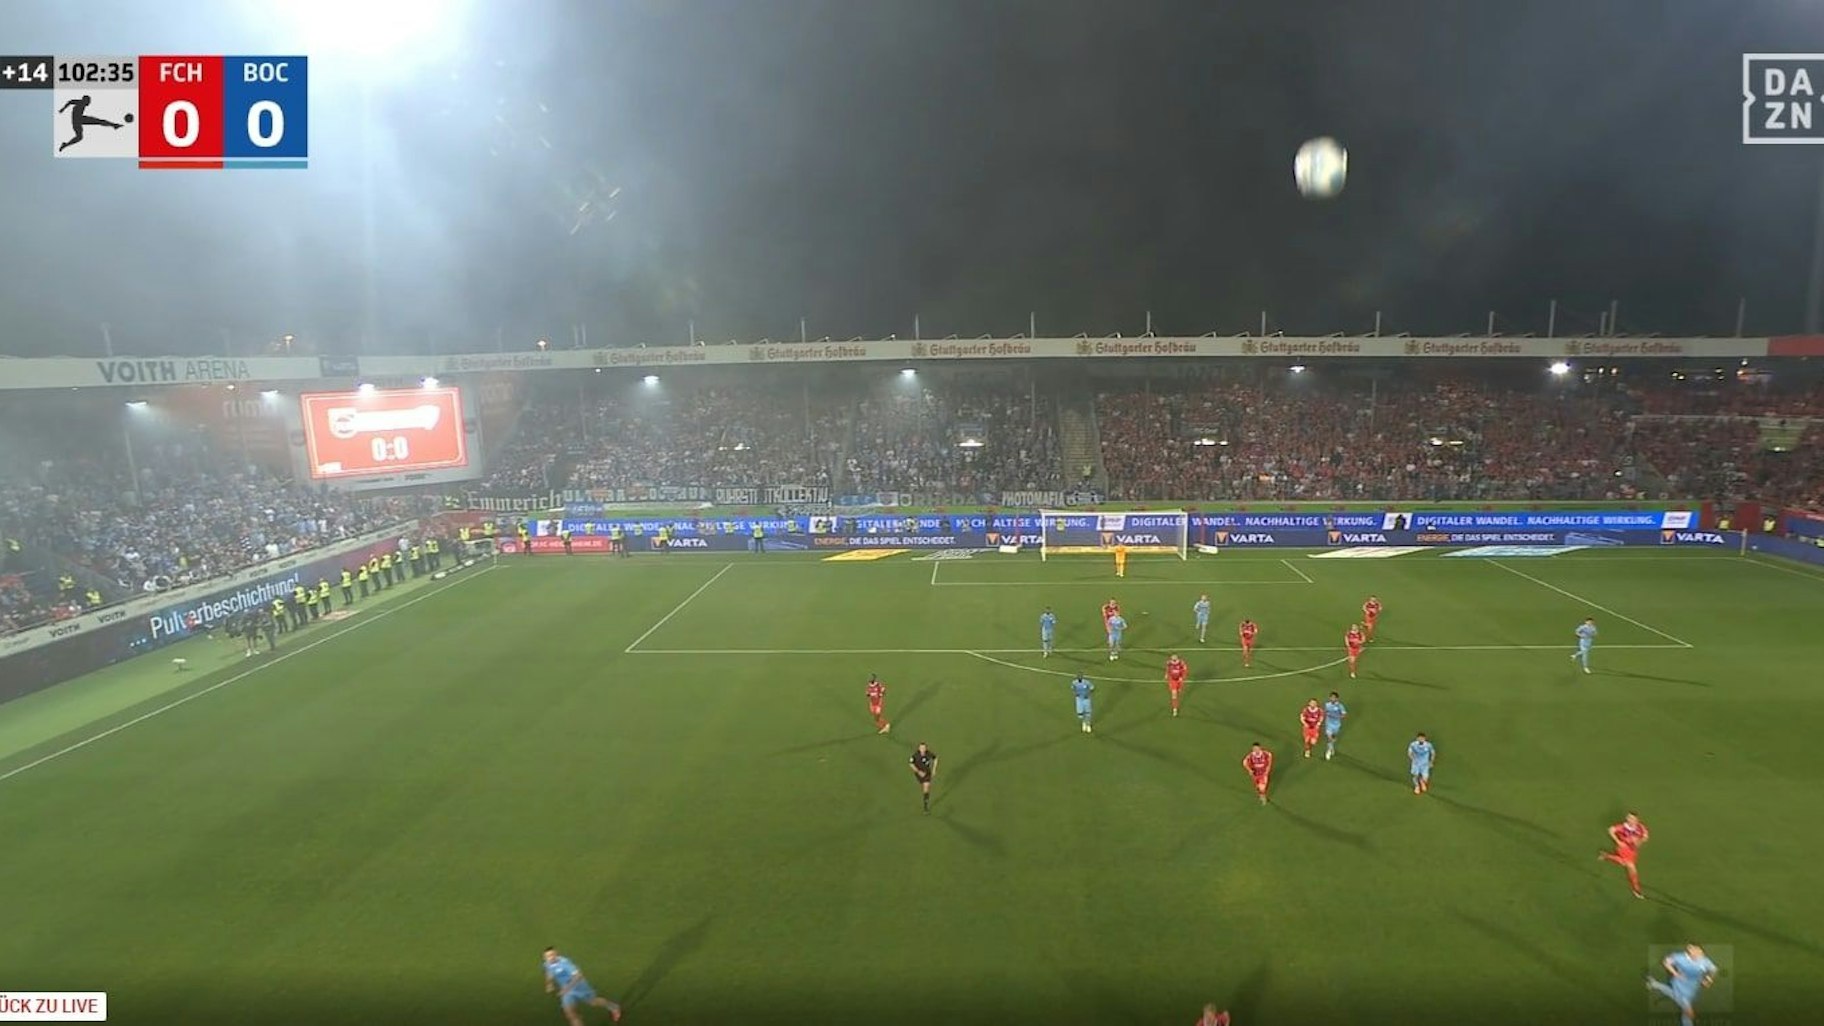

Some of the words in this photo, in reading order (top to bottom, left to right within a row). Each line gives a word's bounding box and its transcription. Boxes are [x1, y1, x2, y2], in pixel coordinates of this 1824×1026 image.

[97, 361, 177, 383] VOITH
[185, 360, 250, 380] ARENA
[371, 436, 409, 461] 0:0
[1245, 517, 1319, 526] NACHHALTIGE
[1417, 516, 1473, 525] DIGITALER
[1476, 516, 1523, 525] WANDEL.
[1527, 516, 1600, 525] NACHHALTIGE
[1603, 516, 1656, 525] WIRKUNG.
[667, 538, 708, 548] VARTA
[849, 537, 862, 545] DIE
[863, 537, 879, 545] DAS
[1001, 535, 1043, 545] VARTA
[1115, 534, 1161, 544] VARTA
[1230, 534, 1275, 544] VARTA
[1343, 533, 1387, 543] VARTA
[1676, 532, 1725, 544] VARTA
[99, 609, 127, 624] VOITH
[48, 622, 81, 638] VOITH
